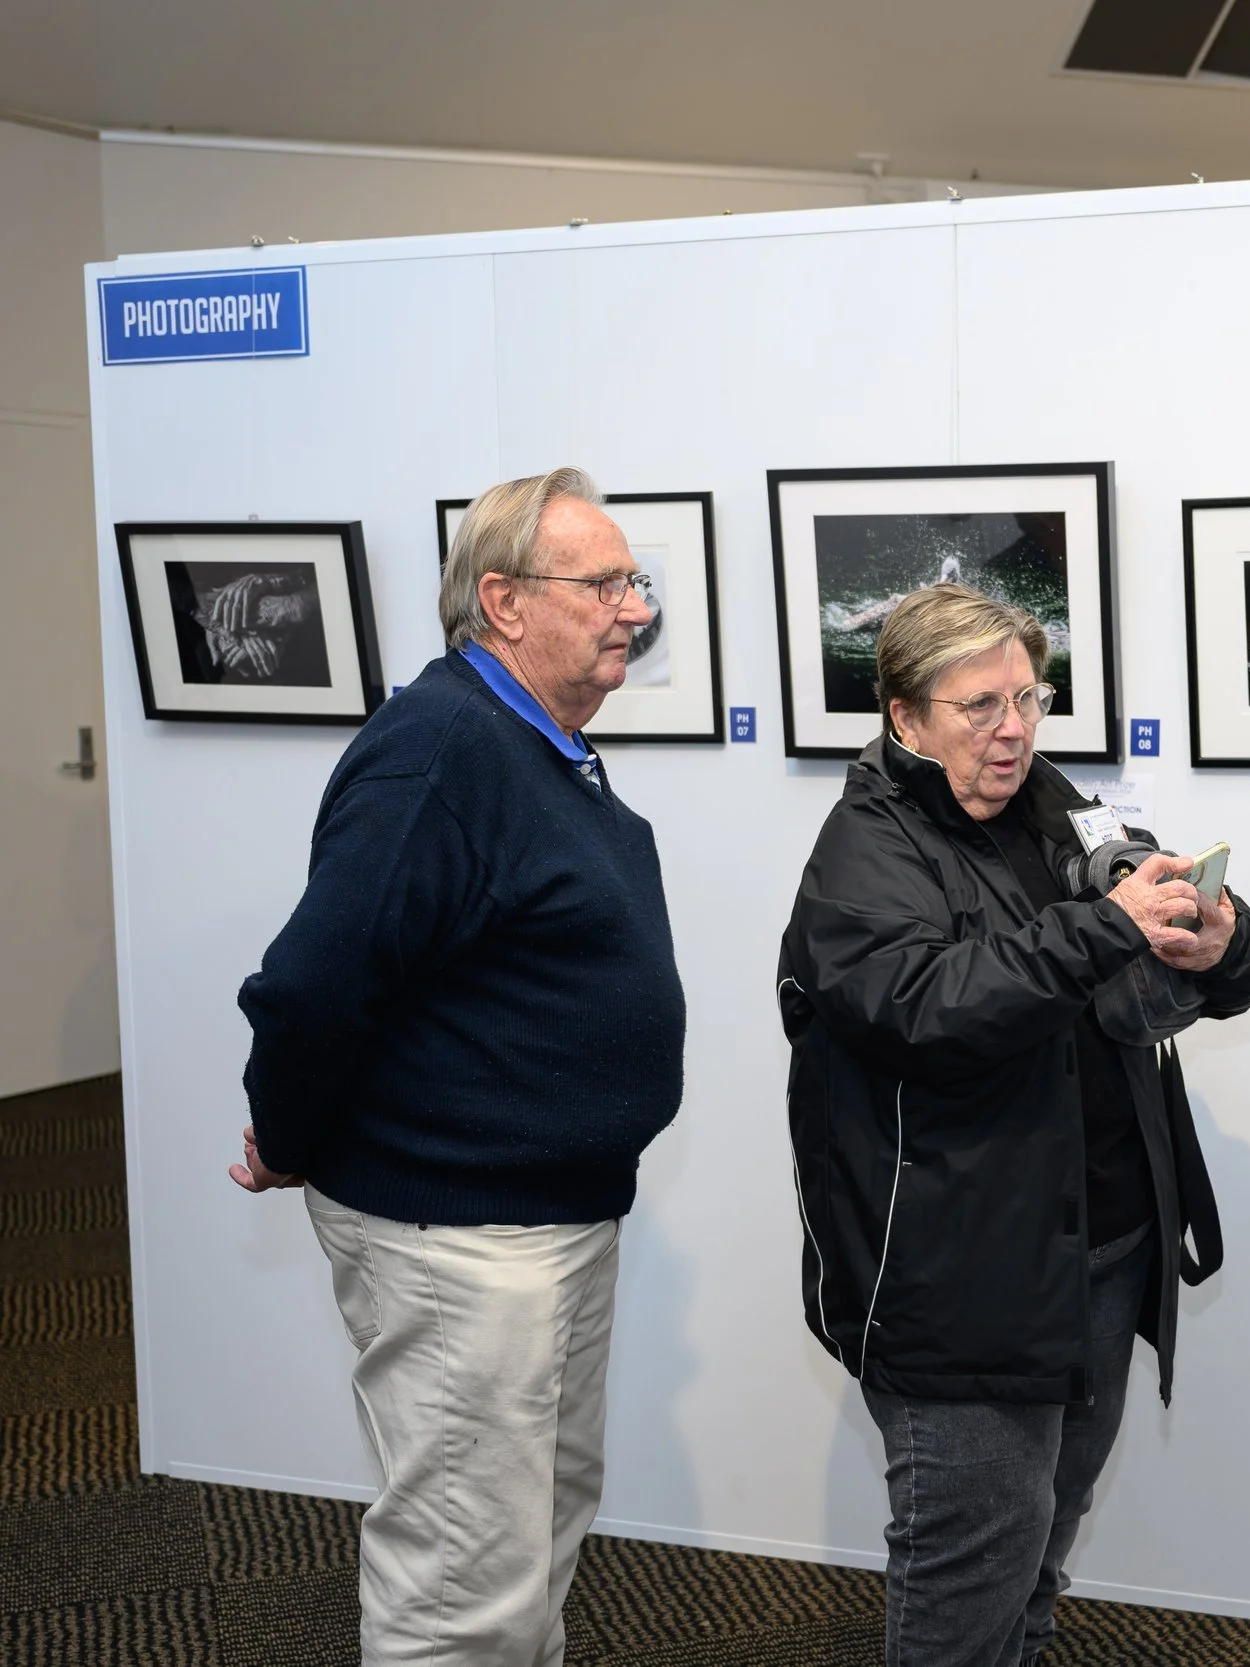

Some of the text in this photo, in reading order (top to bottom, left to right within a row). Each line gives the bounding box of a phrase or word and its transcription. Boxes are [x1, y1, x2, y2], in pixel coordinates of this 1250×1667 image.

[123, 292, 281, 338] PHOTOGRAPHY
[737, 713, 749, 723] PH
[737, 726, 749, 736] 07
[1138, 726, 1152, 736] PH
[1138, 739, 1151, 750] 08
